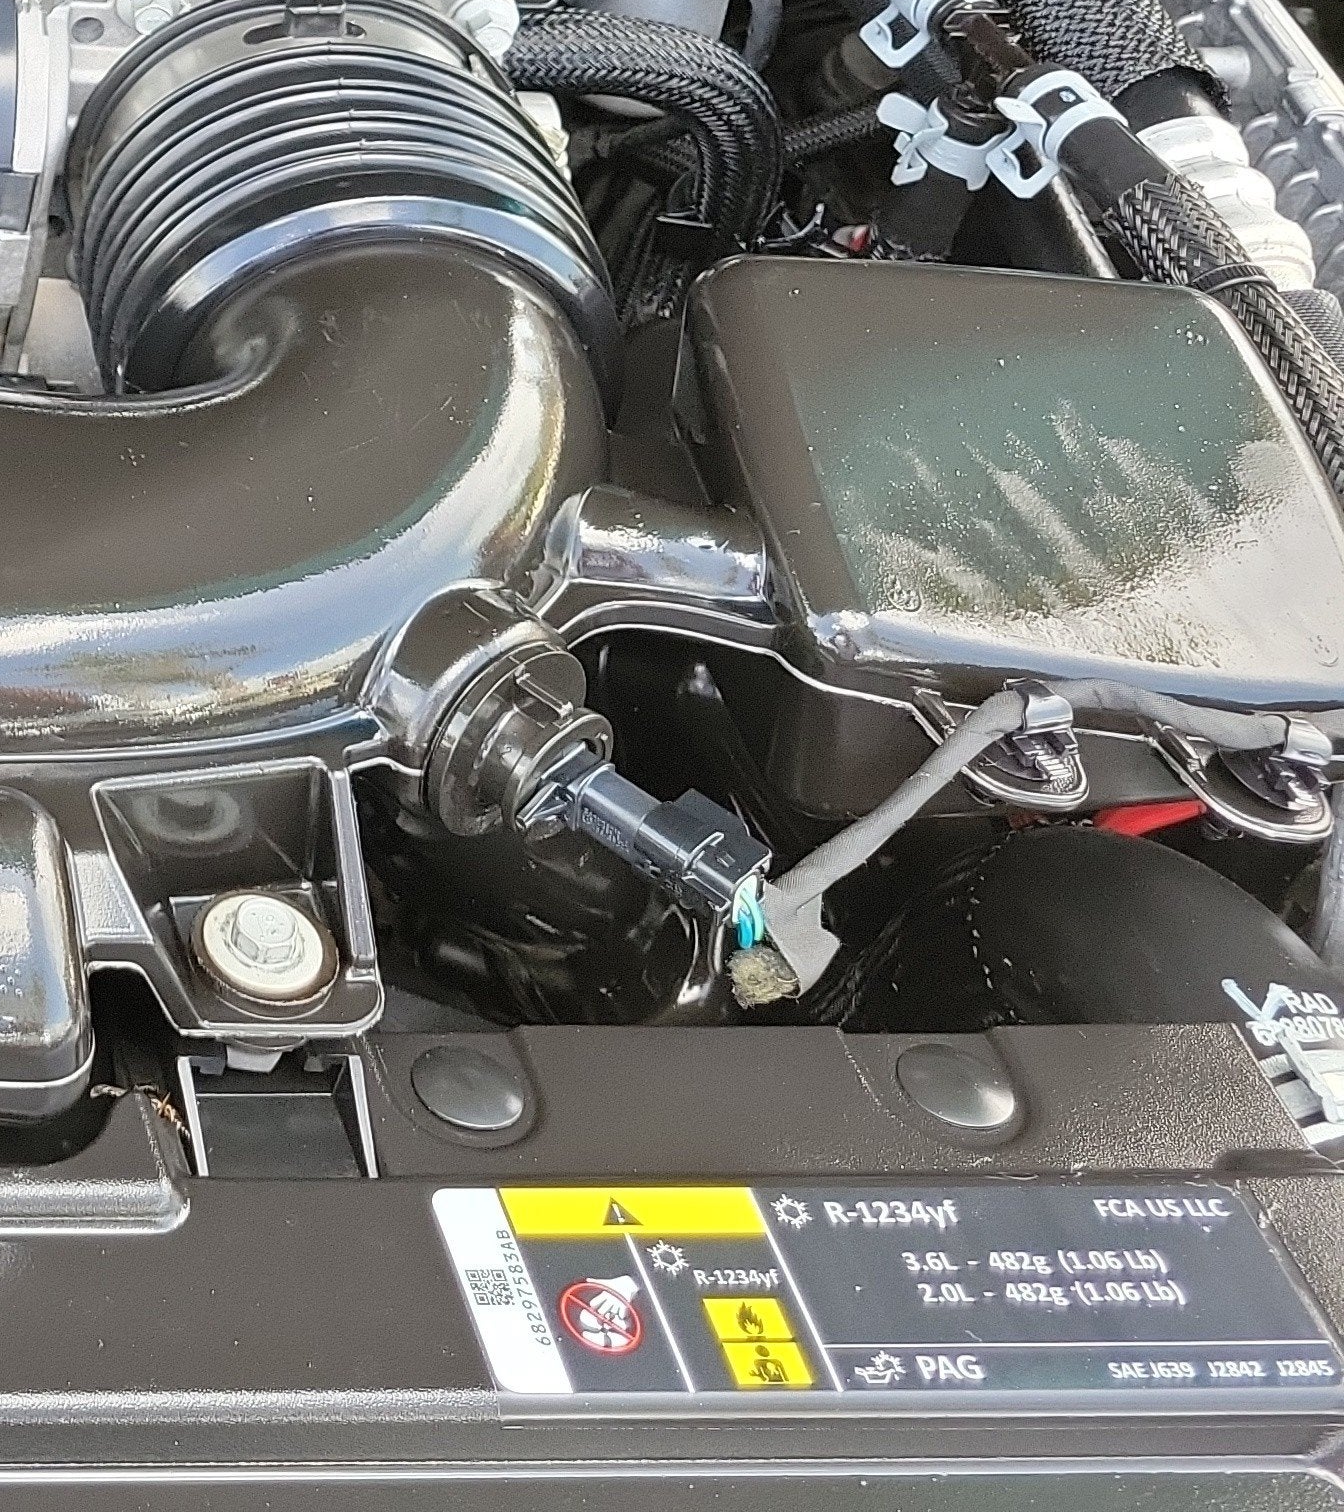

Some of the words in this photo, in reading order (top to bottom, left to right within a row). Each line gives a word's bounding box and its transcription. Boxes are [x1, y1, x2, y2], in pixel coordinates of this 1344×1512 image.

[1280, 991, 1340, 1015] RAD
[824, 1198, 958, 1229] R-1234yf
[1095, 1199, 1146, 1219] FCA
[1152, 1199, 1185, 1219] US
[1188, 1198, 1231, 1218] LLC
[901, 1252, 957, 1272] 3.6L
[990, 1251, 1052, 1276] 482g
[1059, 1250, 1123, 1273] (1.06
[1127, 1249, 1168, 1274] Lb)
[495, 1229, 553, 1348] 68297583AB
[693, 1269, 783, 1289] R-1234yf
[918, 1283, 975, 1304] 2.0L
[1006, 1282, 1069, 1306] 482g
[1073, 1281, 1139, 1306] (1.06
[1144, 1280, 1186, 1306] Lb)
[915, 1354, 985, 1382] PAG
[1107, 1361, 1150, 1379] SAE
[1148, 1359, 1197, 1379] J639
[1207, 1360, 1267, 1378] J2842
[1275, 1359, 1336, 1377] J2845
